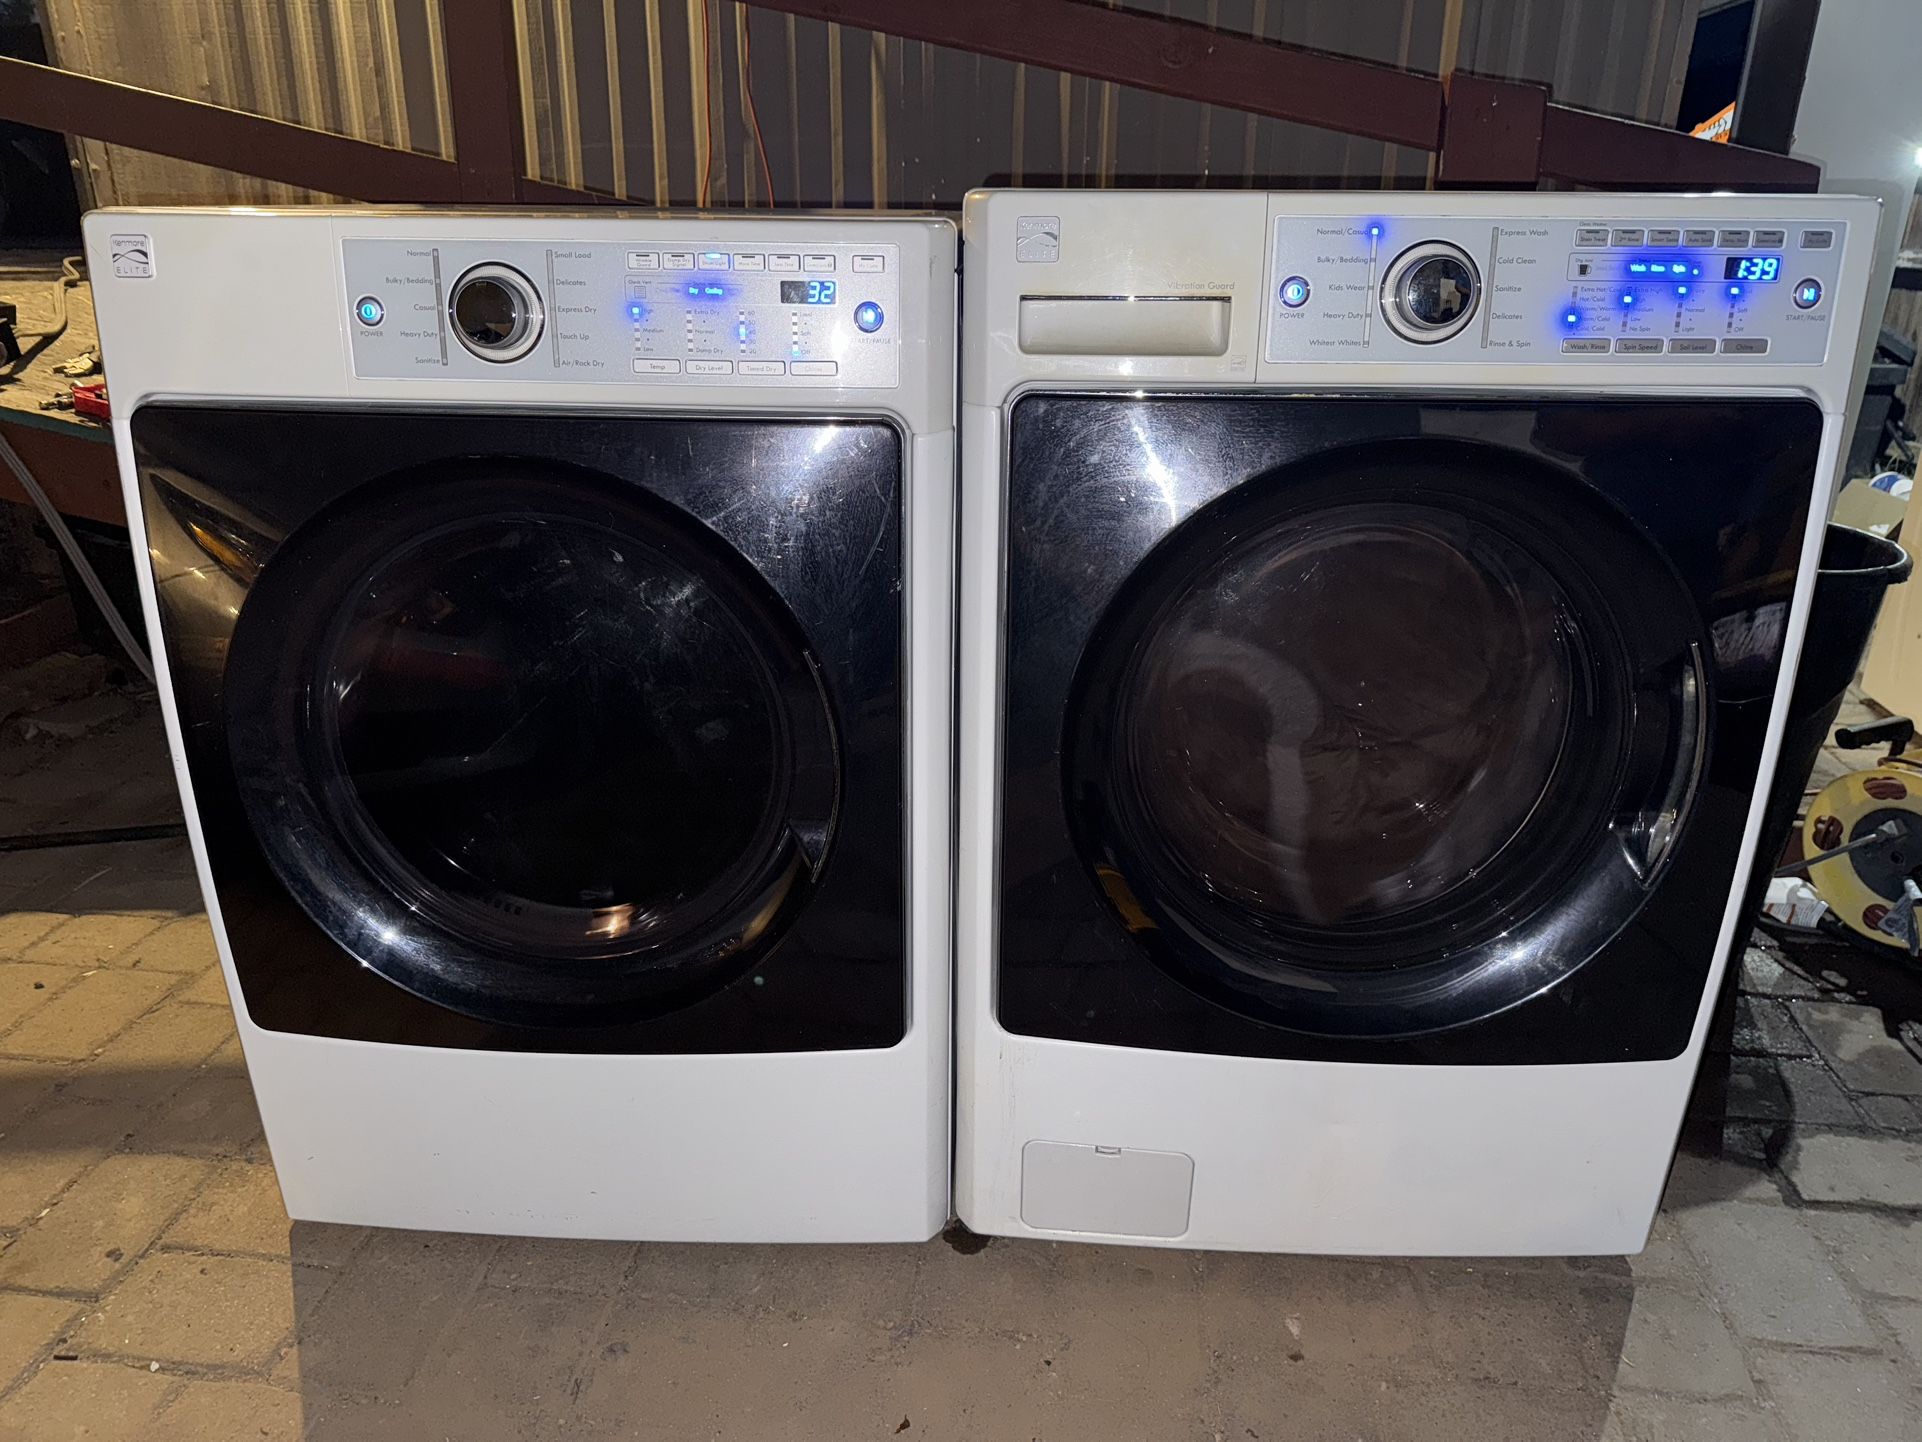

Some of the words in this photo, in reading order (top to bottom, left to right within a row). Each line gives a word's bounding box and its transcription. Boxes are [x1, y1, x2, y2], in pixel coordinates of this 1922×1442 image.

[1500, 229, 1528, 238] Express
[1530, 229, 1549, 237] Wash
[112, 239, 145, 248] Kenmore
[1317, 256, 1368, 265] Bulky/Bedding
[1737, 258, 1778, 280] 1:39
[385, 277, 434, 286] Bulky/Bedding
[1167, 282, 1205, 290] Vibration
[1208, 282, 1235, 290] Guard
[1494, 284, 1522, 292] Sanitize
[808, 282, 834, 304] 32
[558, 306, 583, 314] Express
[585, 306, 597, 315] Dry
[1322, 312, 1345, 320] Heavy
[1348, 312, 1364, 320] Duty
[400, 331, 421, 339] Heavy
[423, 331, 438, 340] Duty
[580, 333, 590, 342] Up
[1516, 340, 1531, 348] Spin
[1624, 344, 1637, 352] Spin
[1638, 344, 1658, 352] Speed
[561, 360, 590, 368] Air/Rack
[592, 360, 604, 368] Dry
